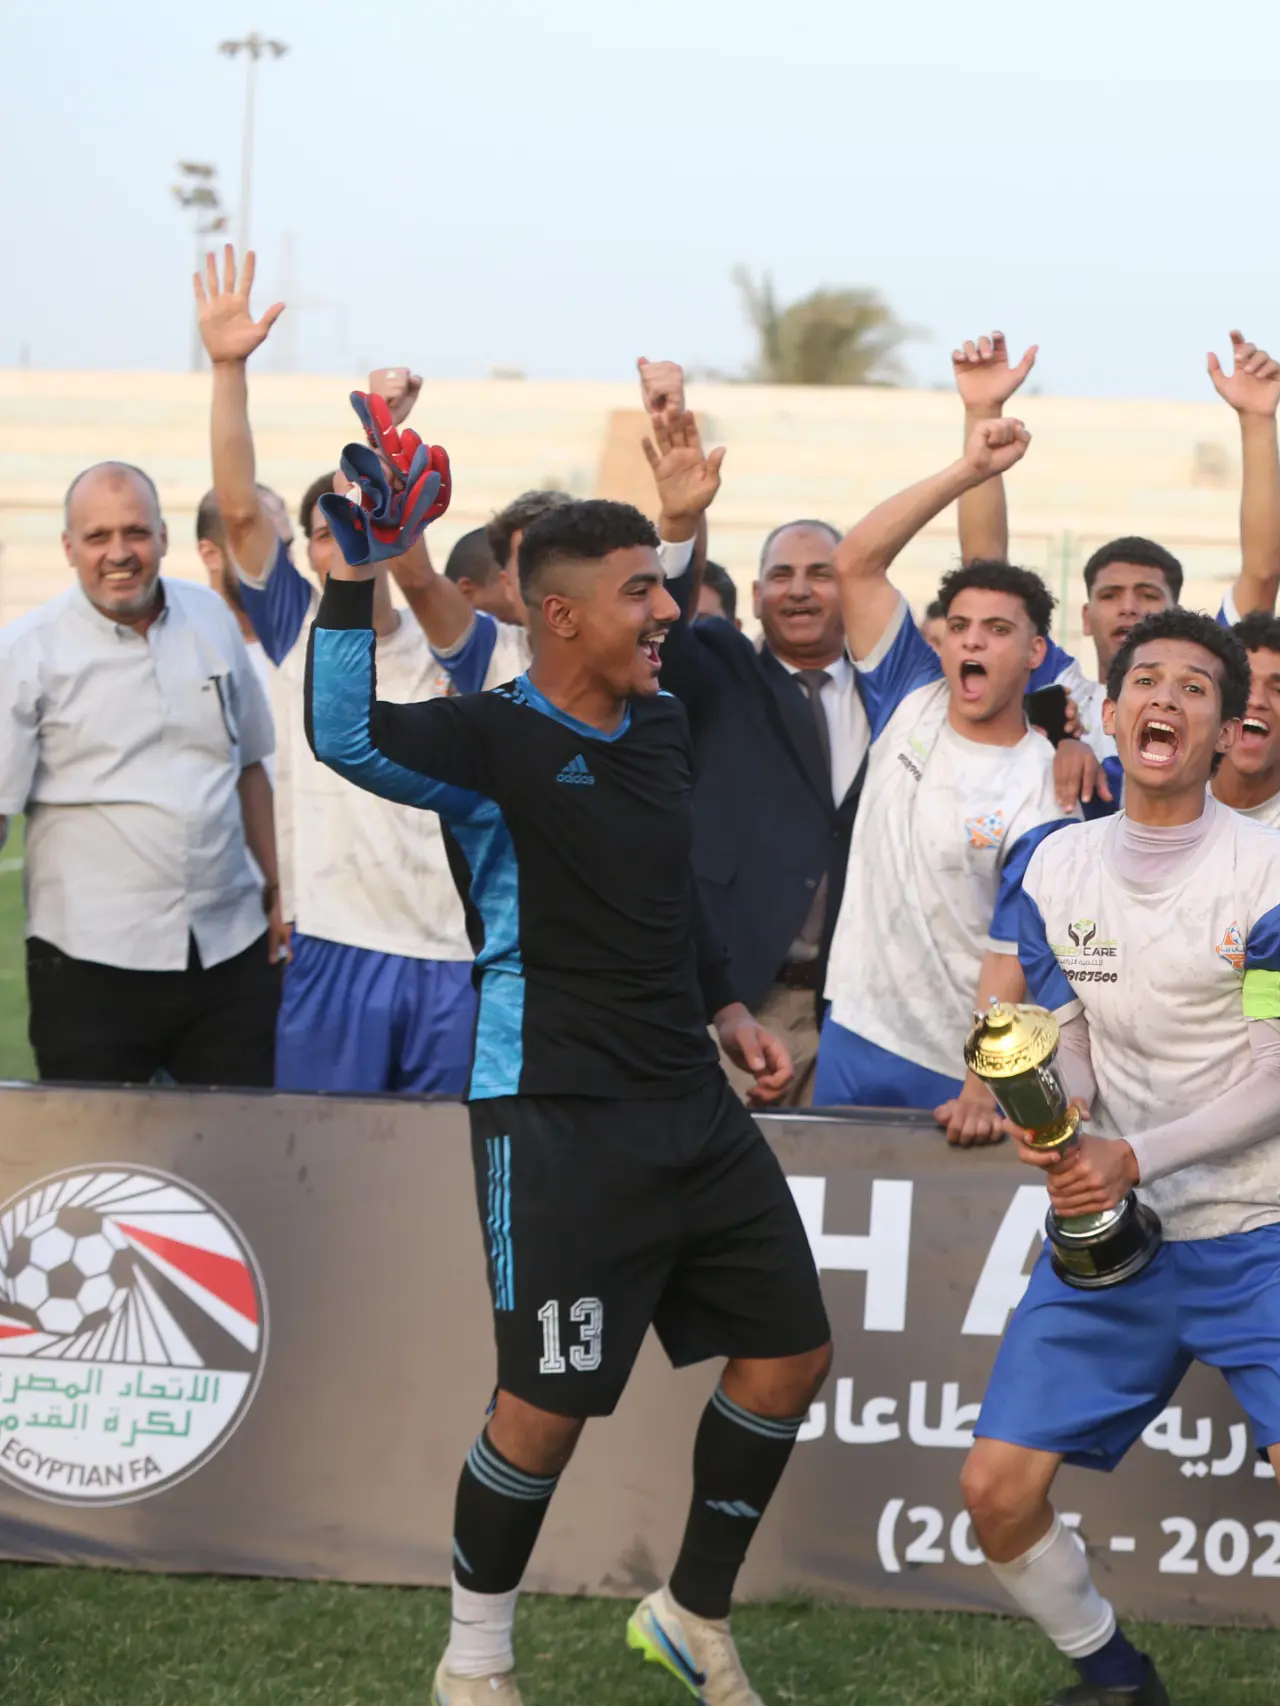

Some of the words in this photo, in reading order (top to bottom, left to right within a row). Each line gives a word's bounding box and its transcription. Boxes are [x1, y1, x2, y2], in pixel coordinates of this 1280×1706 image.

[1083, 947, 1117, 957] CARE
[537, 1296, 603, 1374] 13
[0, 1367, 103, 1404] المصر
[118, 1369, 220, 1404] الاتحاد
[104, 1407, 192, 1448] لكرة
[1, 1437, 124, 1487] EGYPTIAN
[129, 1455, 162, 1483] FA
